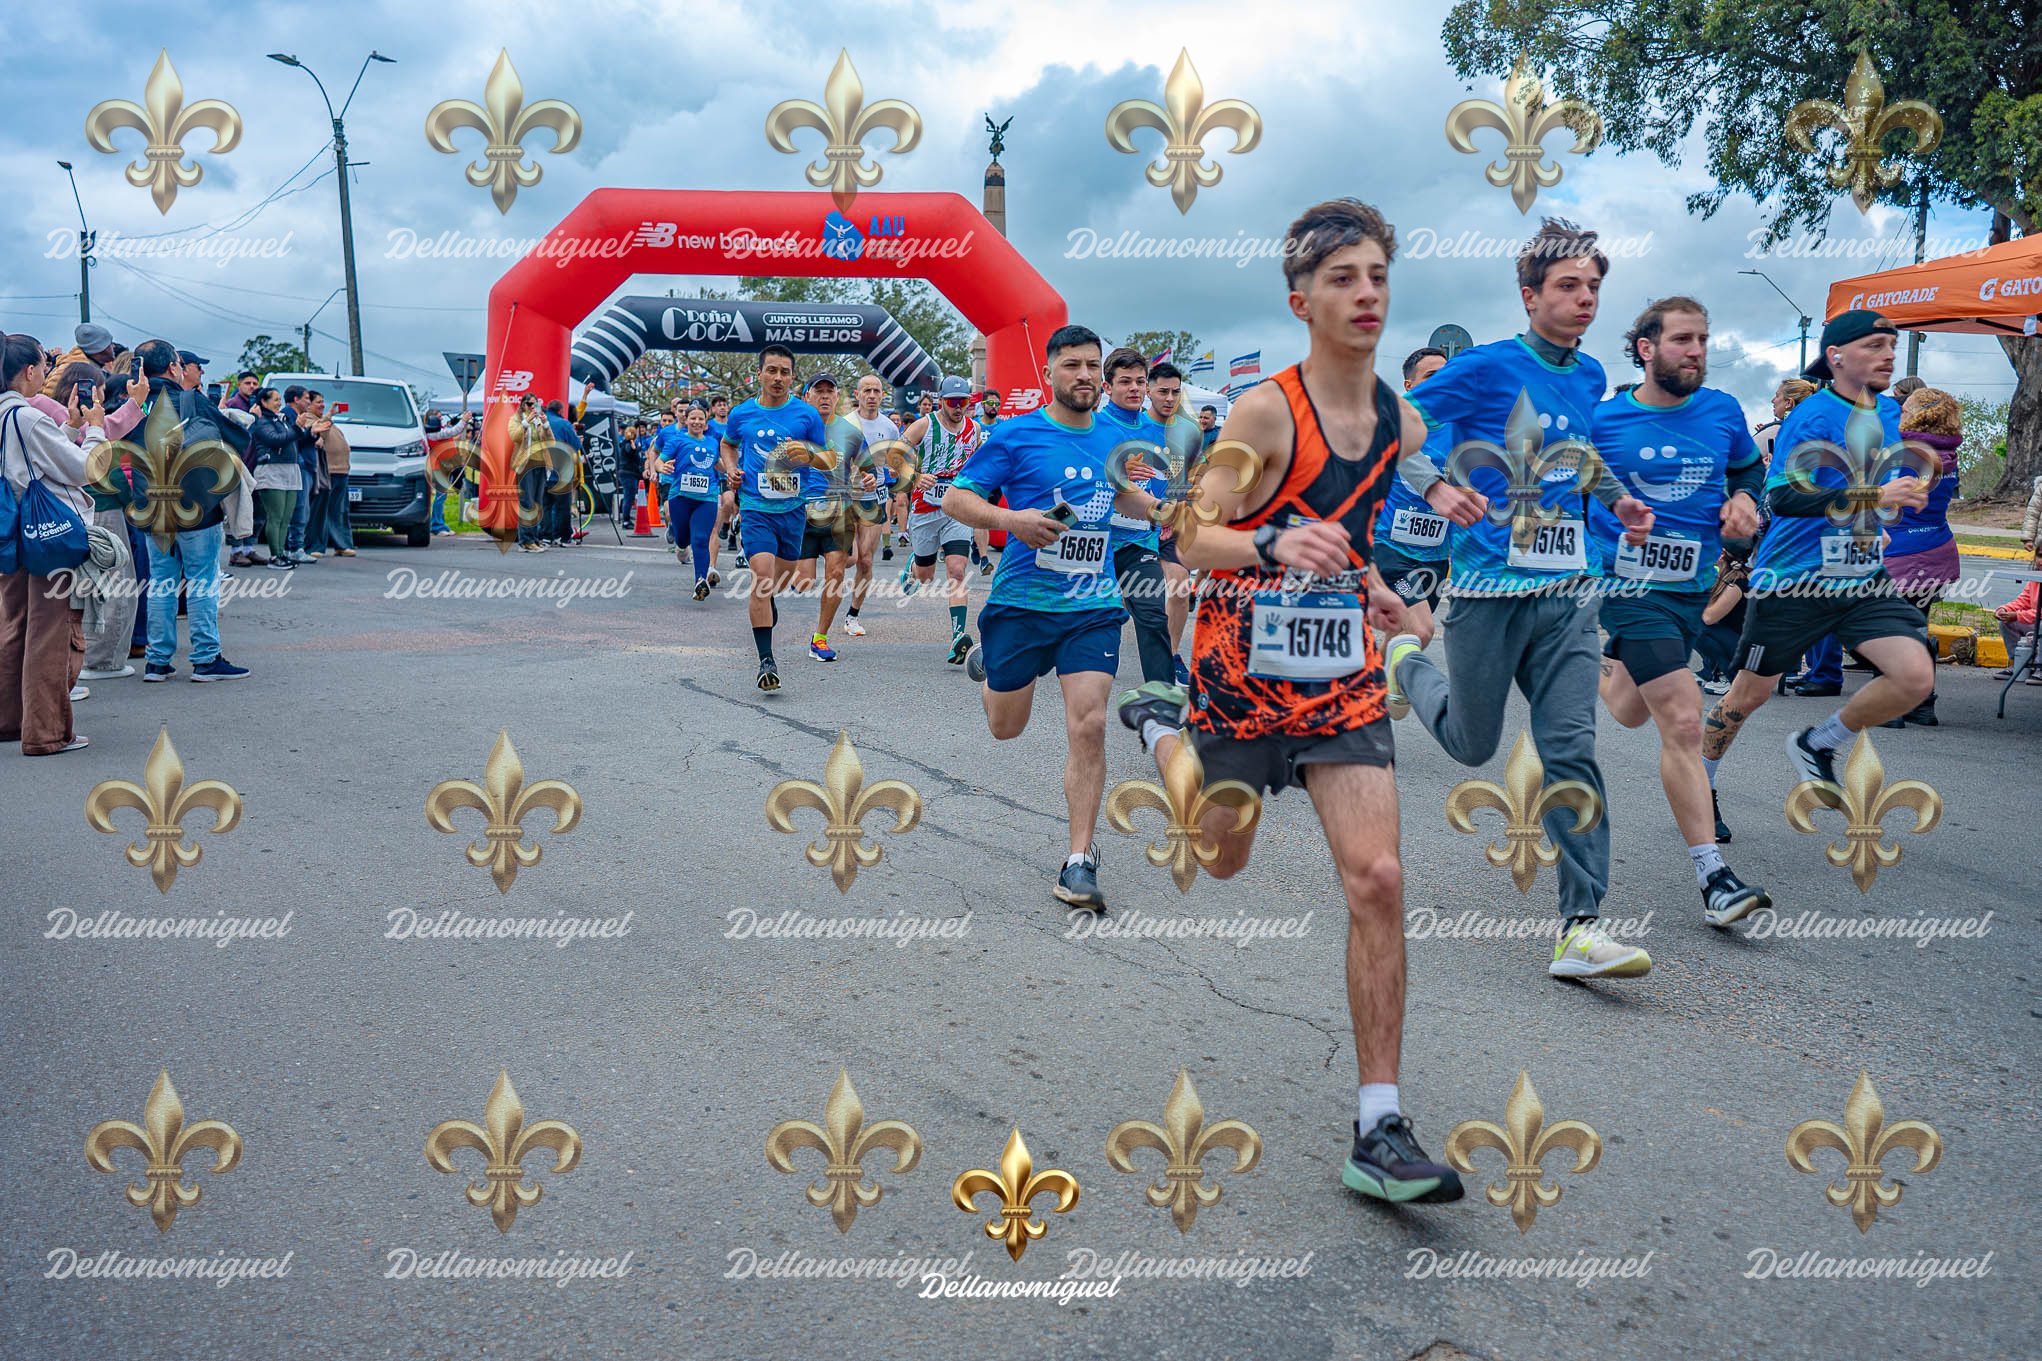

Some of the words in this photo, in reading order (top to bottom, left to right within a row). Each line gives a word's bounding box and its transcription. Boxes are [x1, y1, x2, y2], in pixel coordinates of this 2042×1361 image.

[869, 216, 904, 236] AAU
[678, 234, 716, 249] new
[720, 233, 797, 251] balance
[1866, 287, 1940, 309] GATORADE
[687, 309, 732, 323] Doña
[769, 316, 807, 324] JUNTOS
[808, 316, 858, 325] LLEGAMOS
[765, 327, 806, 342] MÁS
[809, 329, 862, 342] LEJOS
[690, 477, 708, 488] 16522
[1408, 517, 1444, 539] 15867
[1060, 536, 1105, 562] 15863
[1533, 525, 1576, 556] 15743
[1640, 542, 1694, 572] 15936
[1286, 616, 1352, 659] 15748
